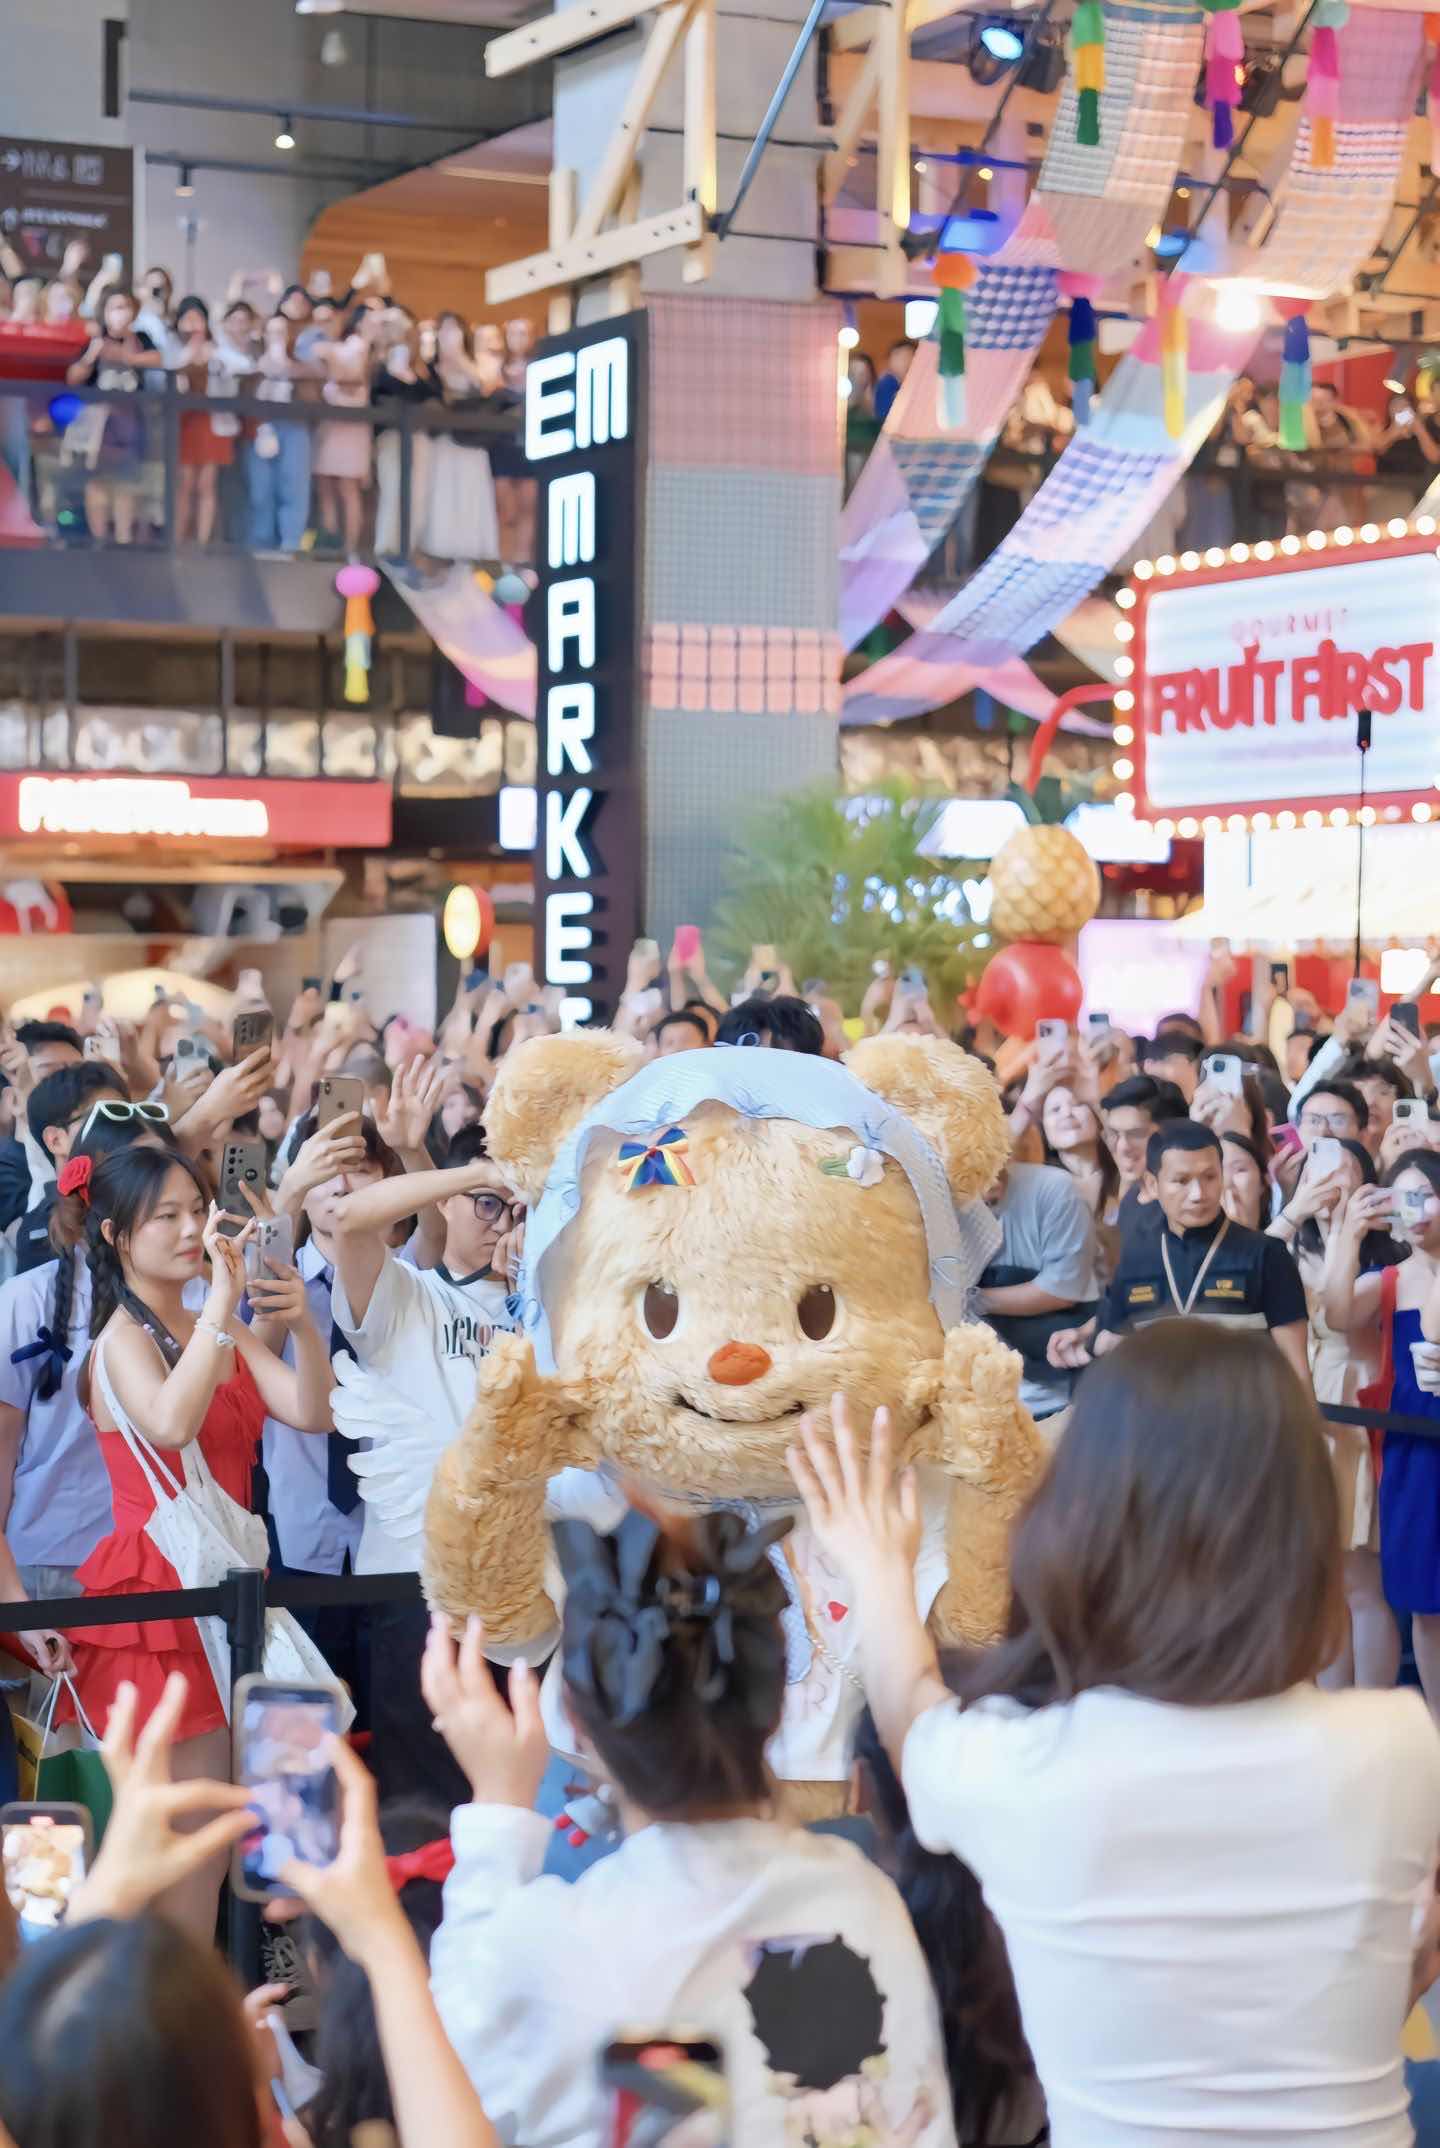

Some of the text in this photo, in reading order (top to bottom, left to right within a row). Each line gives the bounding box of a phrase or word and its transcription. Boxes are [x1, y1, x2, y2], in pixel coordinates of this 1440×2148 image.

[525, 336, 628, 461] EM
[1147, 638, 1434, 736] FRUIT FIRST
